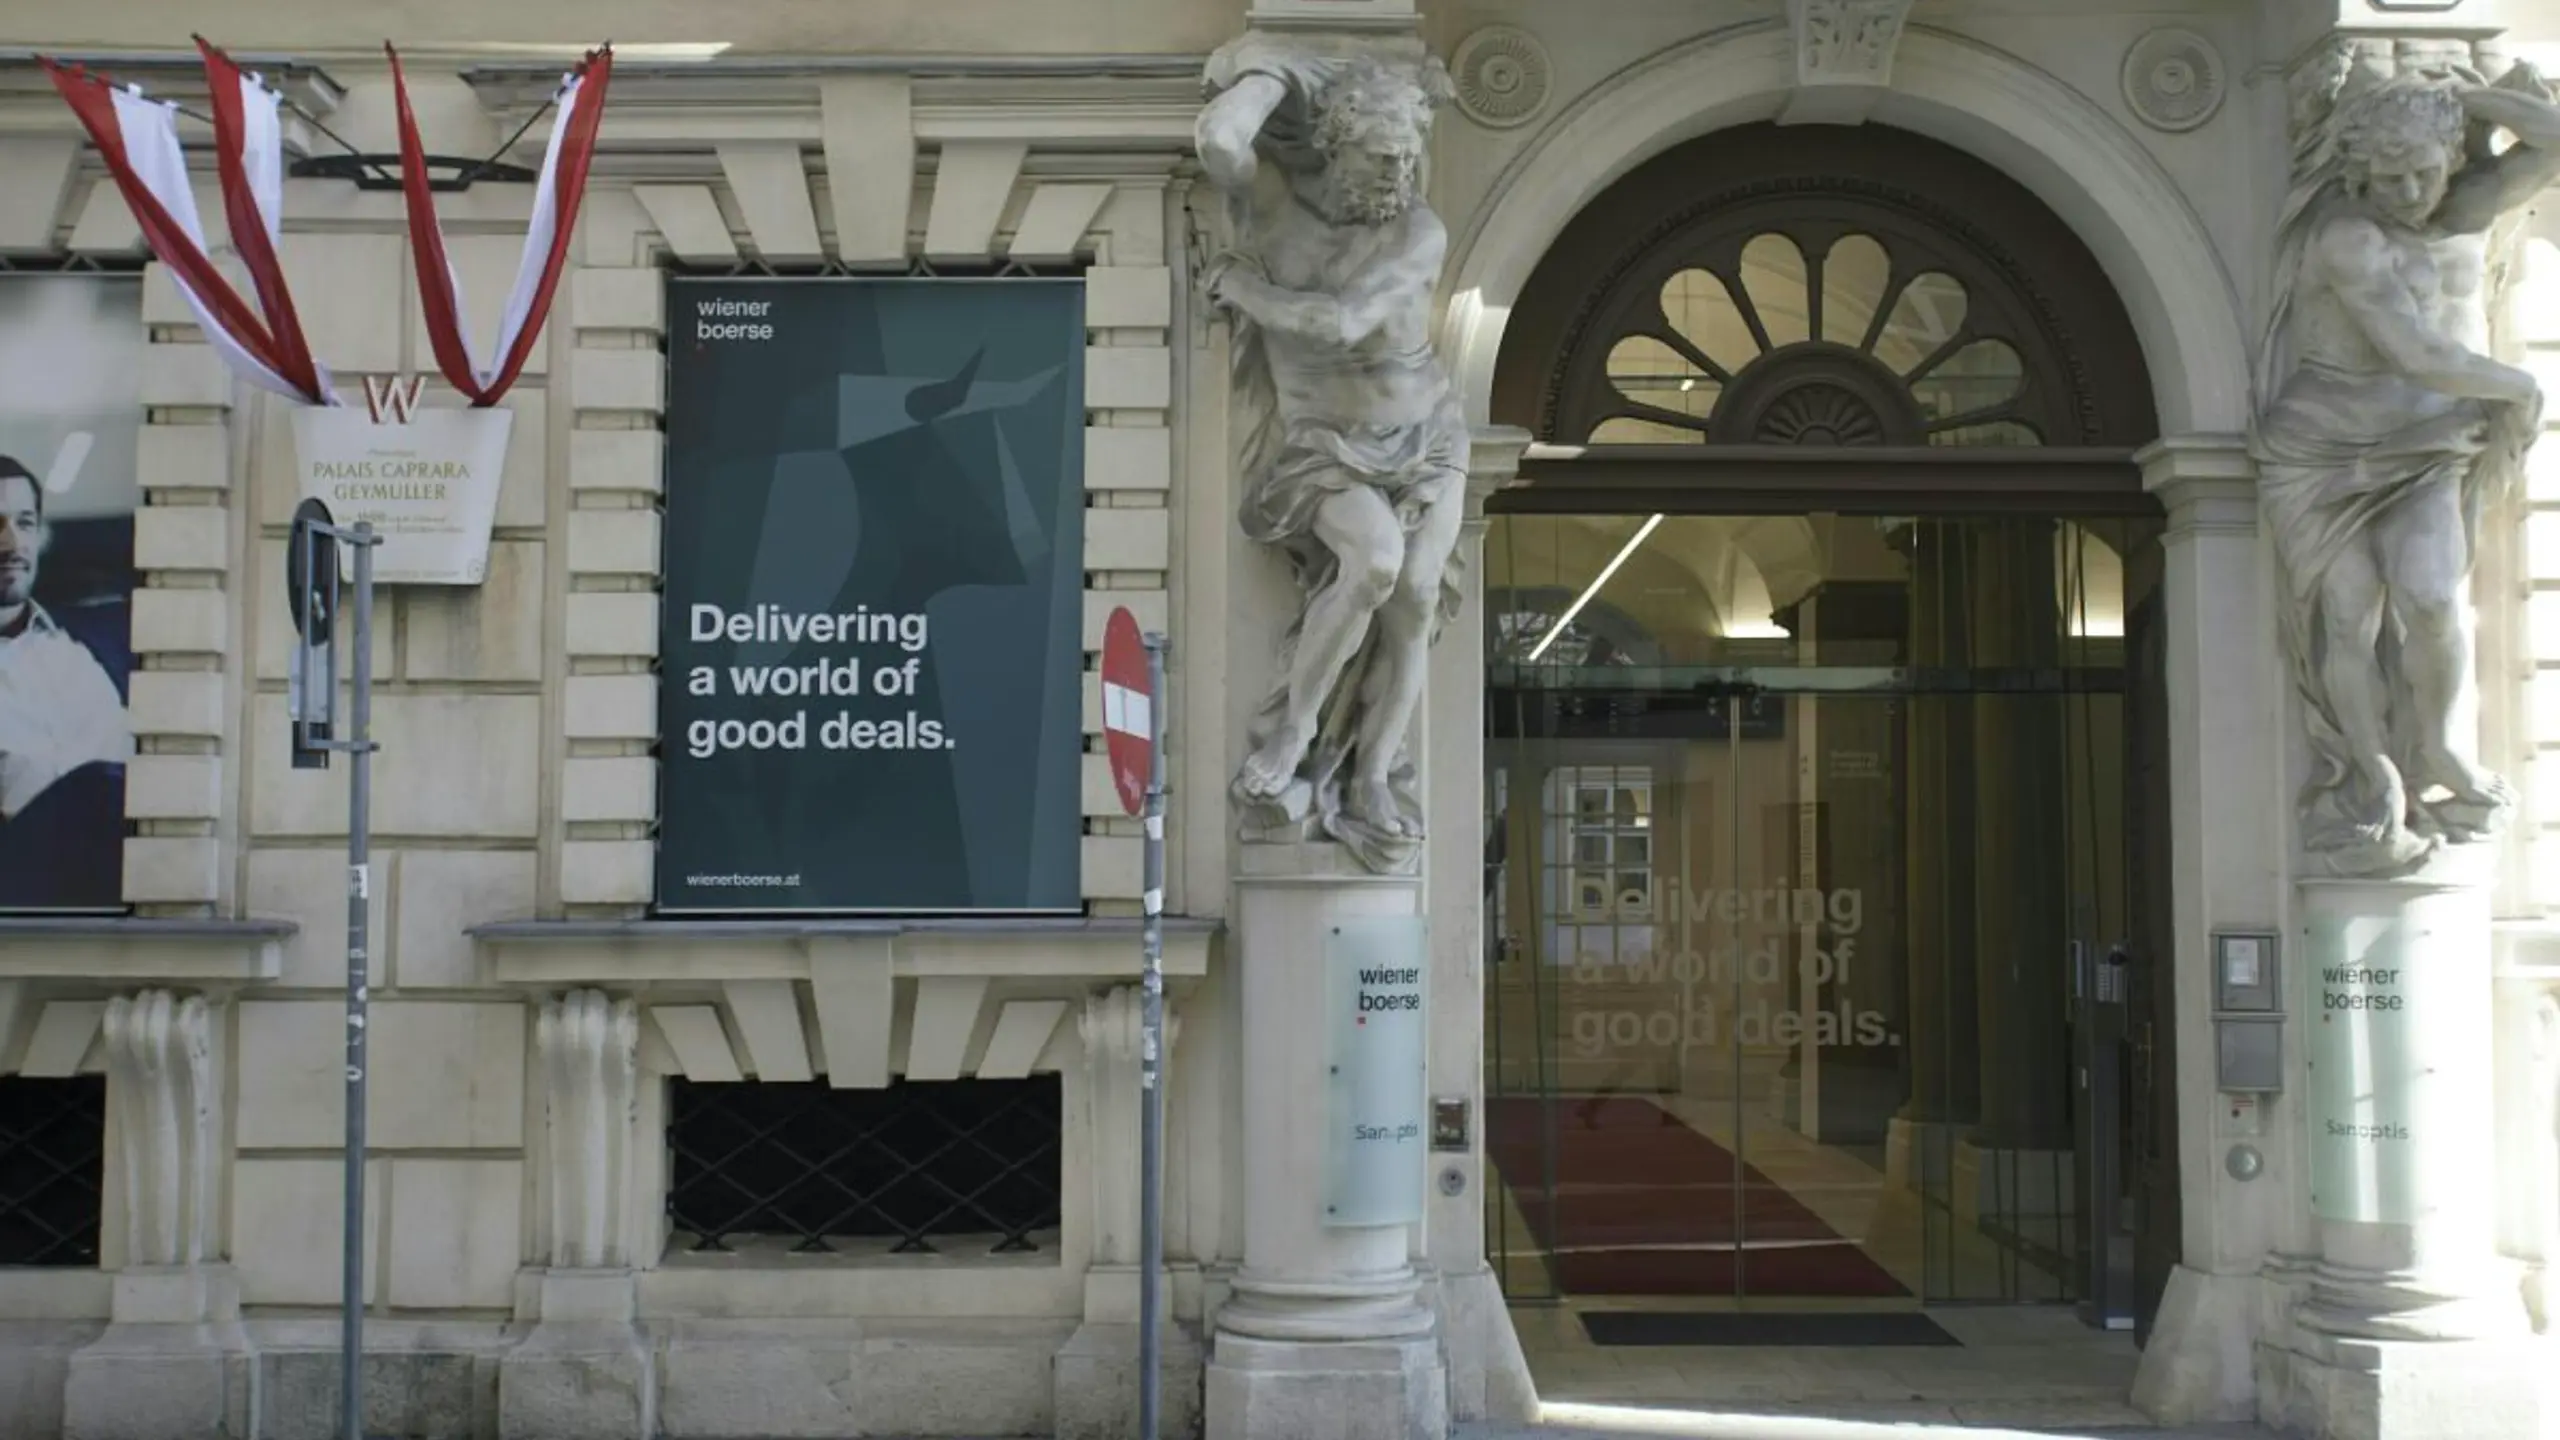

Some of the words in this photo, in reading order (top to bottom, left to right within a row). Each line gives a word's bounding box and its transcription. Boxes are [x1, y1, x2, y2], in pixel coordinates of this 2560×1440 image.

[698, 298, 770, 318] wiener
[697, 320, 774, 340] boerse
[313, 461, 374, 478] PALAIS
[381, 461, 470, 478] CAPRARA
[689, 603, 928, 650] Delivering
[688, 666, 716, 696] a
[730, 657, 860, 696] world
[873, 657, 921, 696] of
[687, 711, 807, 759] good
[820, 711, 956, 750] deals.
[686, 871, 801, 887] wienerboerse.at
[1574, 876, 1862, 934] Delivering
[1572, 952, 1605, 984] a
[1620, 939, 1780, 984] world
[1798, 938, 1856, 984] of
[1359, 963, 1420, 985] wiener
[2322, 962, 2400, 985] wiener
[1359, 990, 1420, 1011] boerse
[2323, 988, 2404, 1010] boerse
[1572, 999, 1716, 1057] good
[1735, 999, 1900, 1047] deals.
